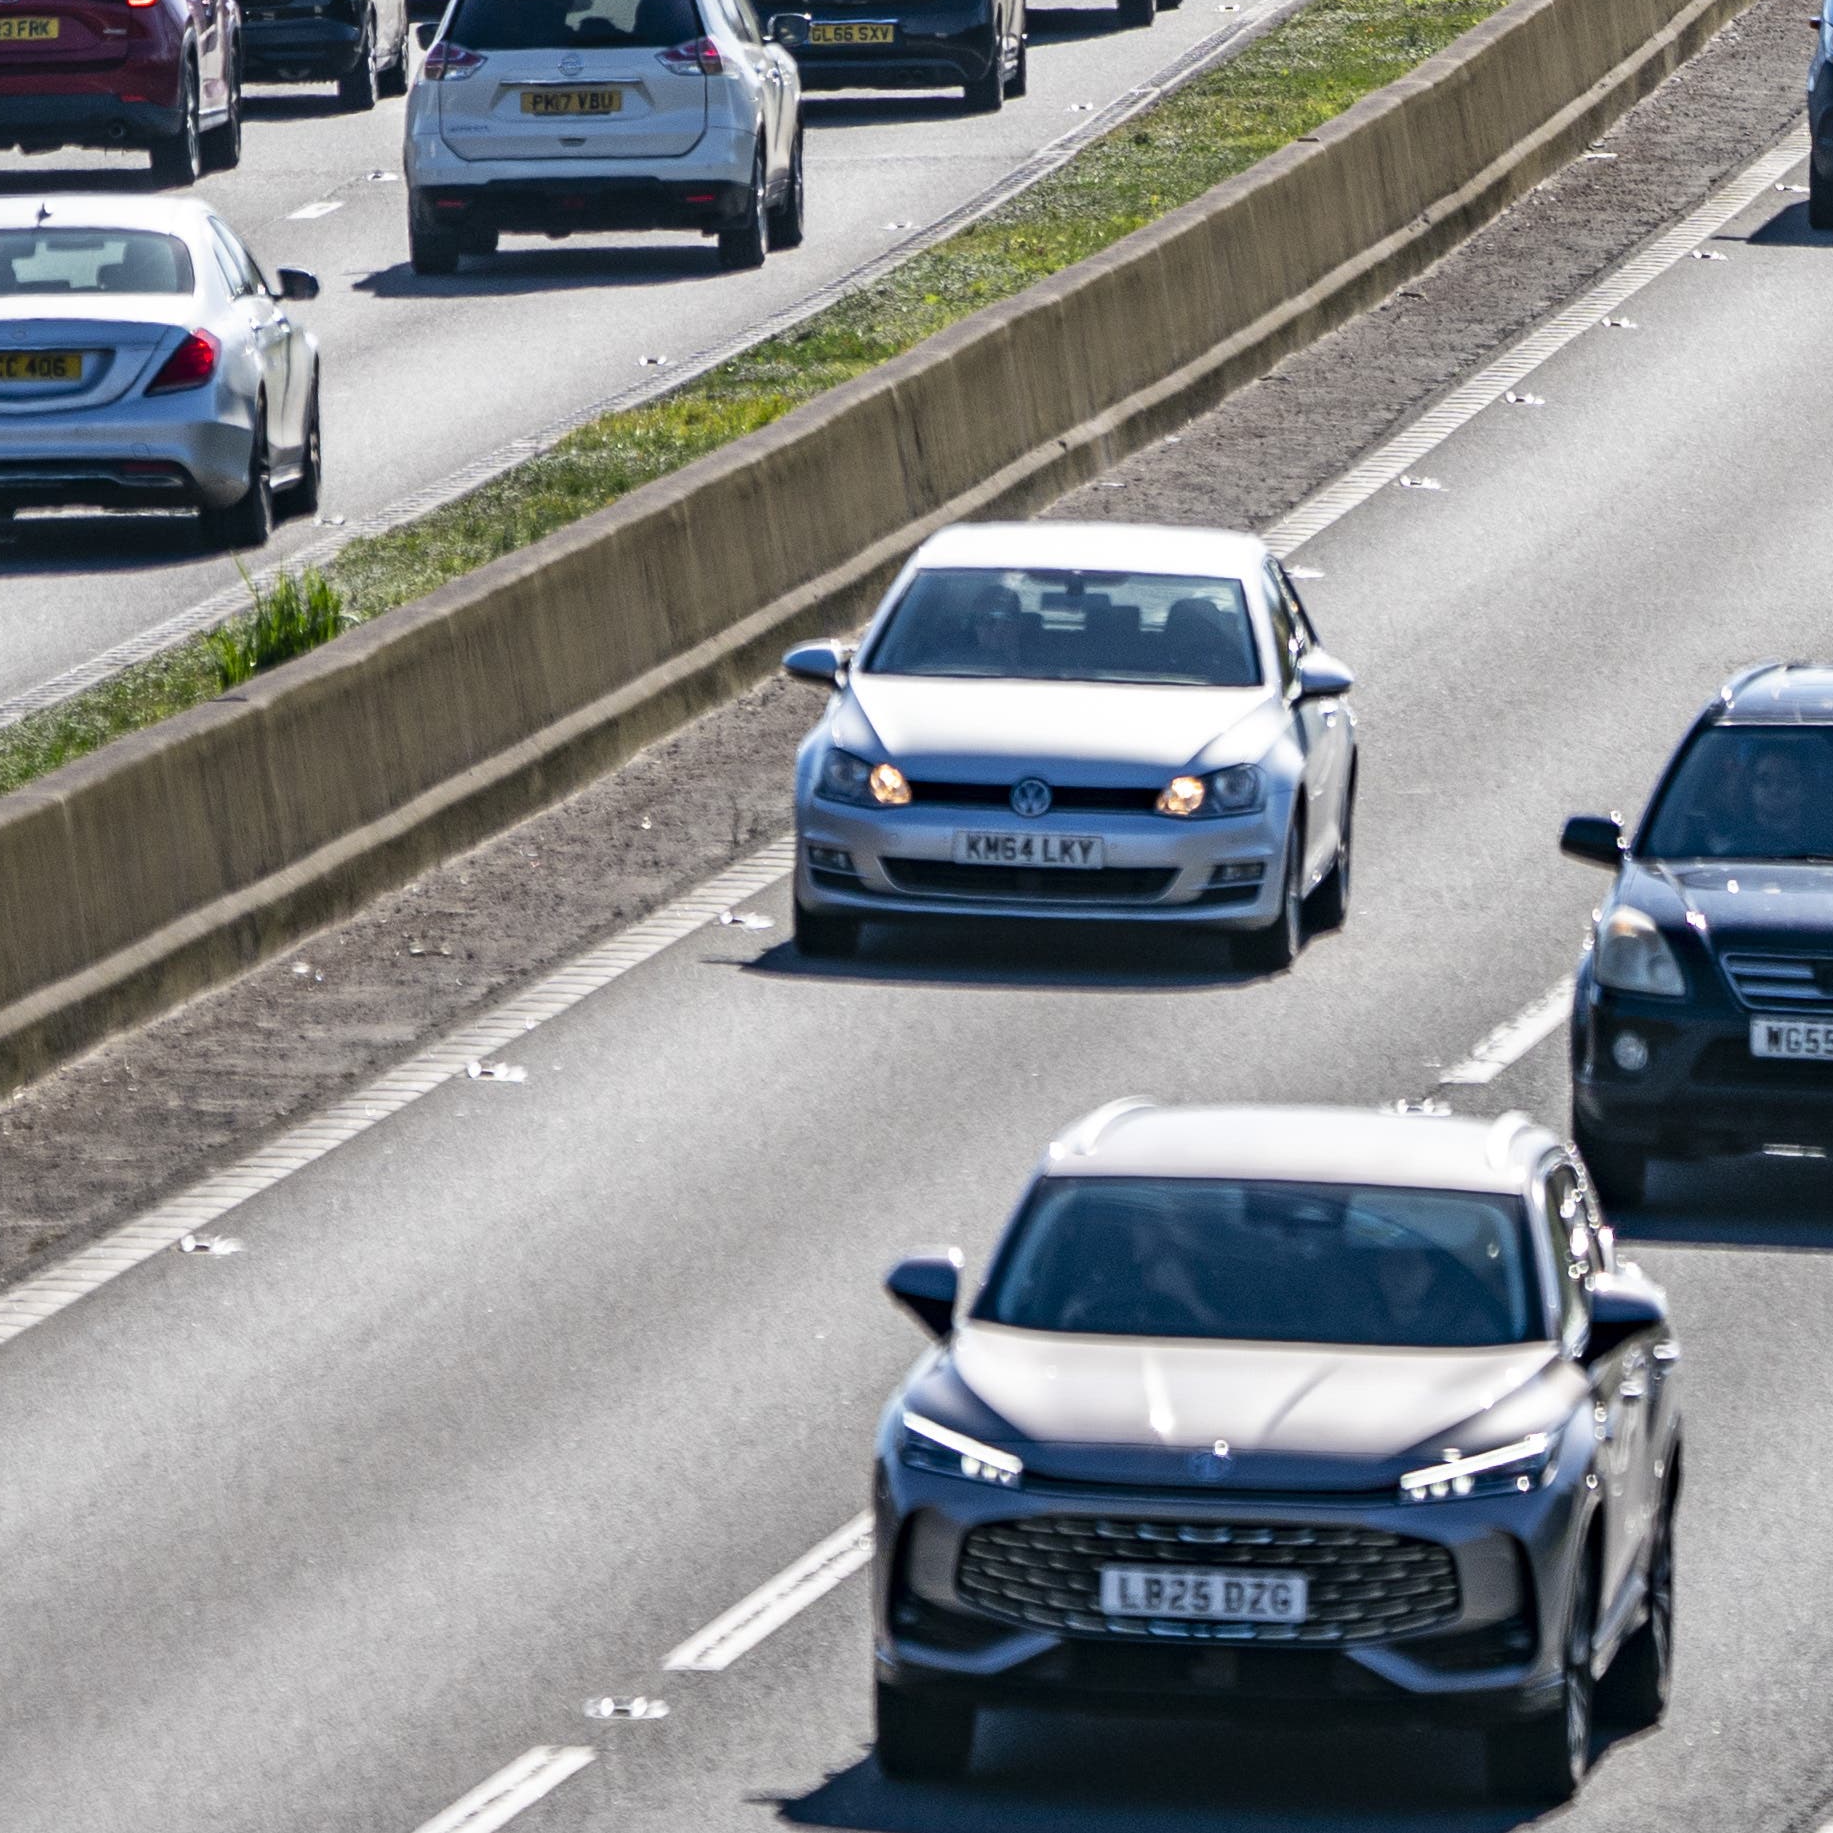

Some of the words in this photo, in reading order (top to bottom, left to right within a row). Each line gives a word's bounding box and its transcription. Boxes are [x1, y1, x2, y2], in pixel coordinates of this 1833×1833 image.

[17, 19, 50, 37] FRK
[811, 26, 853, 42] GL66
[858, 25, 890, 41] SXV
[575, 92, 614, 110] VBU
[966, 834, 1034, 864] KM64
[1042, 837, 1094, 866] LKY
